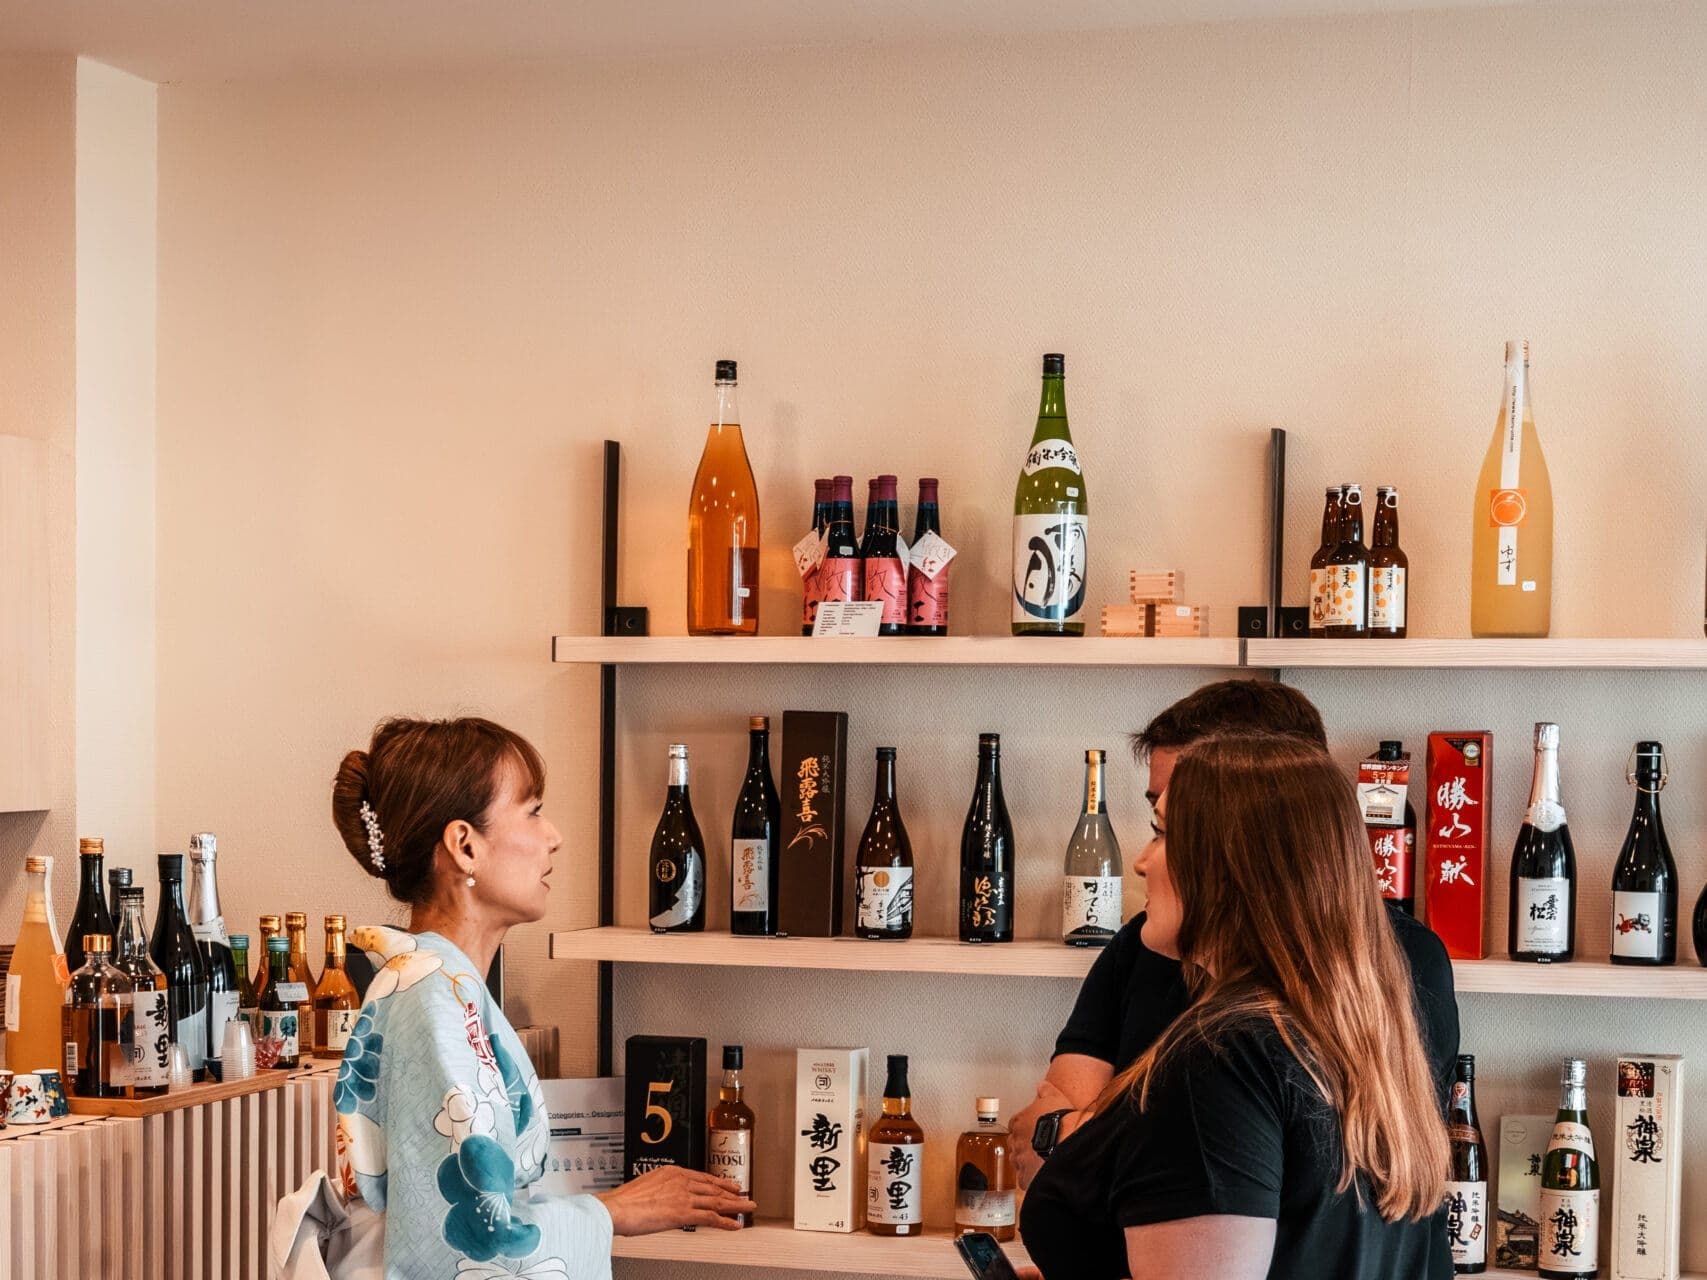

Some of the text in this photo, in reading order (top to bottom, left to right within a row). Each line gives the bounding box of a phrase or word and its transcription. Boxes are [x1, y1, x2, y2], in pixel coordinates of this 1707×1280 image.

[796, 757, 820, 823] 飛露喜
[548, 1111, 585, 1120] Categories
[640, 1079, 674, 1144] 5
[801, 1113, 843, 1191] 新里
[1552, 1133, 1592, 1146] 純米大吟醸
[1627, 1115, 1662, 1163] 神泉
[880, 1146, 914, 1210] 新里
[1549, 1208, 1581, 1257] 神泉
[1636, 1213, 1648, 1256] 純米大吟醸
